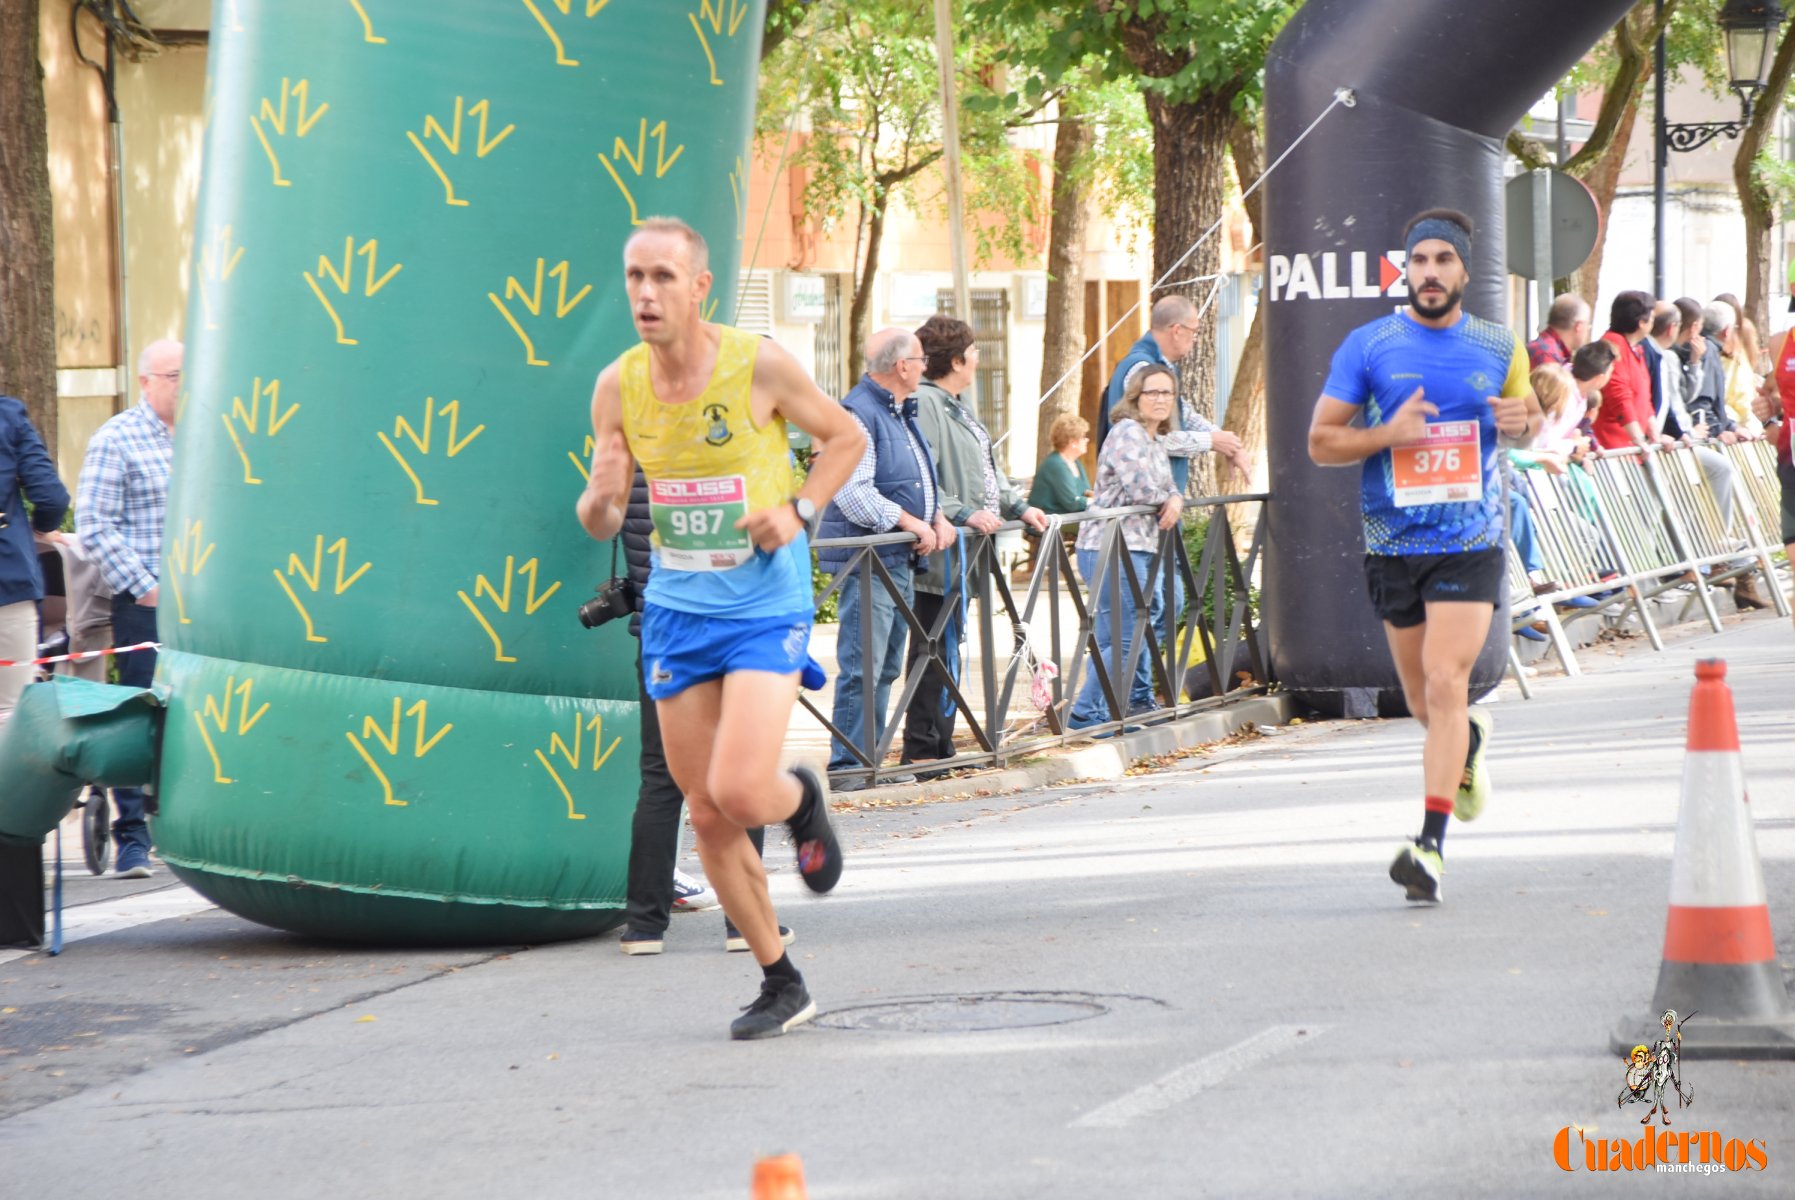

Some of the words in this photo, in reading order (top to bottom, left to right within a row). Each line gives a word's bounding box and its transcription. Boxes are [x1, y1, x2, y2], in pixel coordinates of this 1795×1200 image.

[1414, 449, 1460, 473] 376
[655, 480, 736, 497] SOLISS
[671, 509, 724, 535] 987
